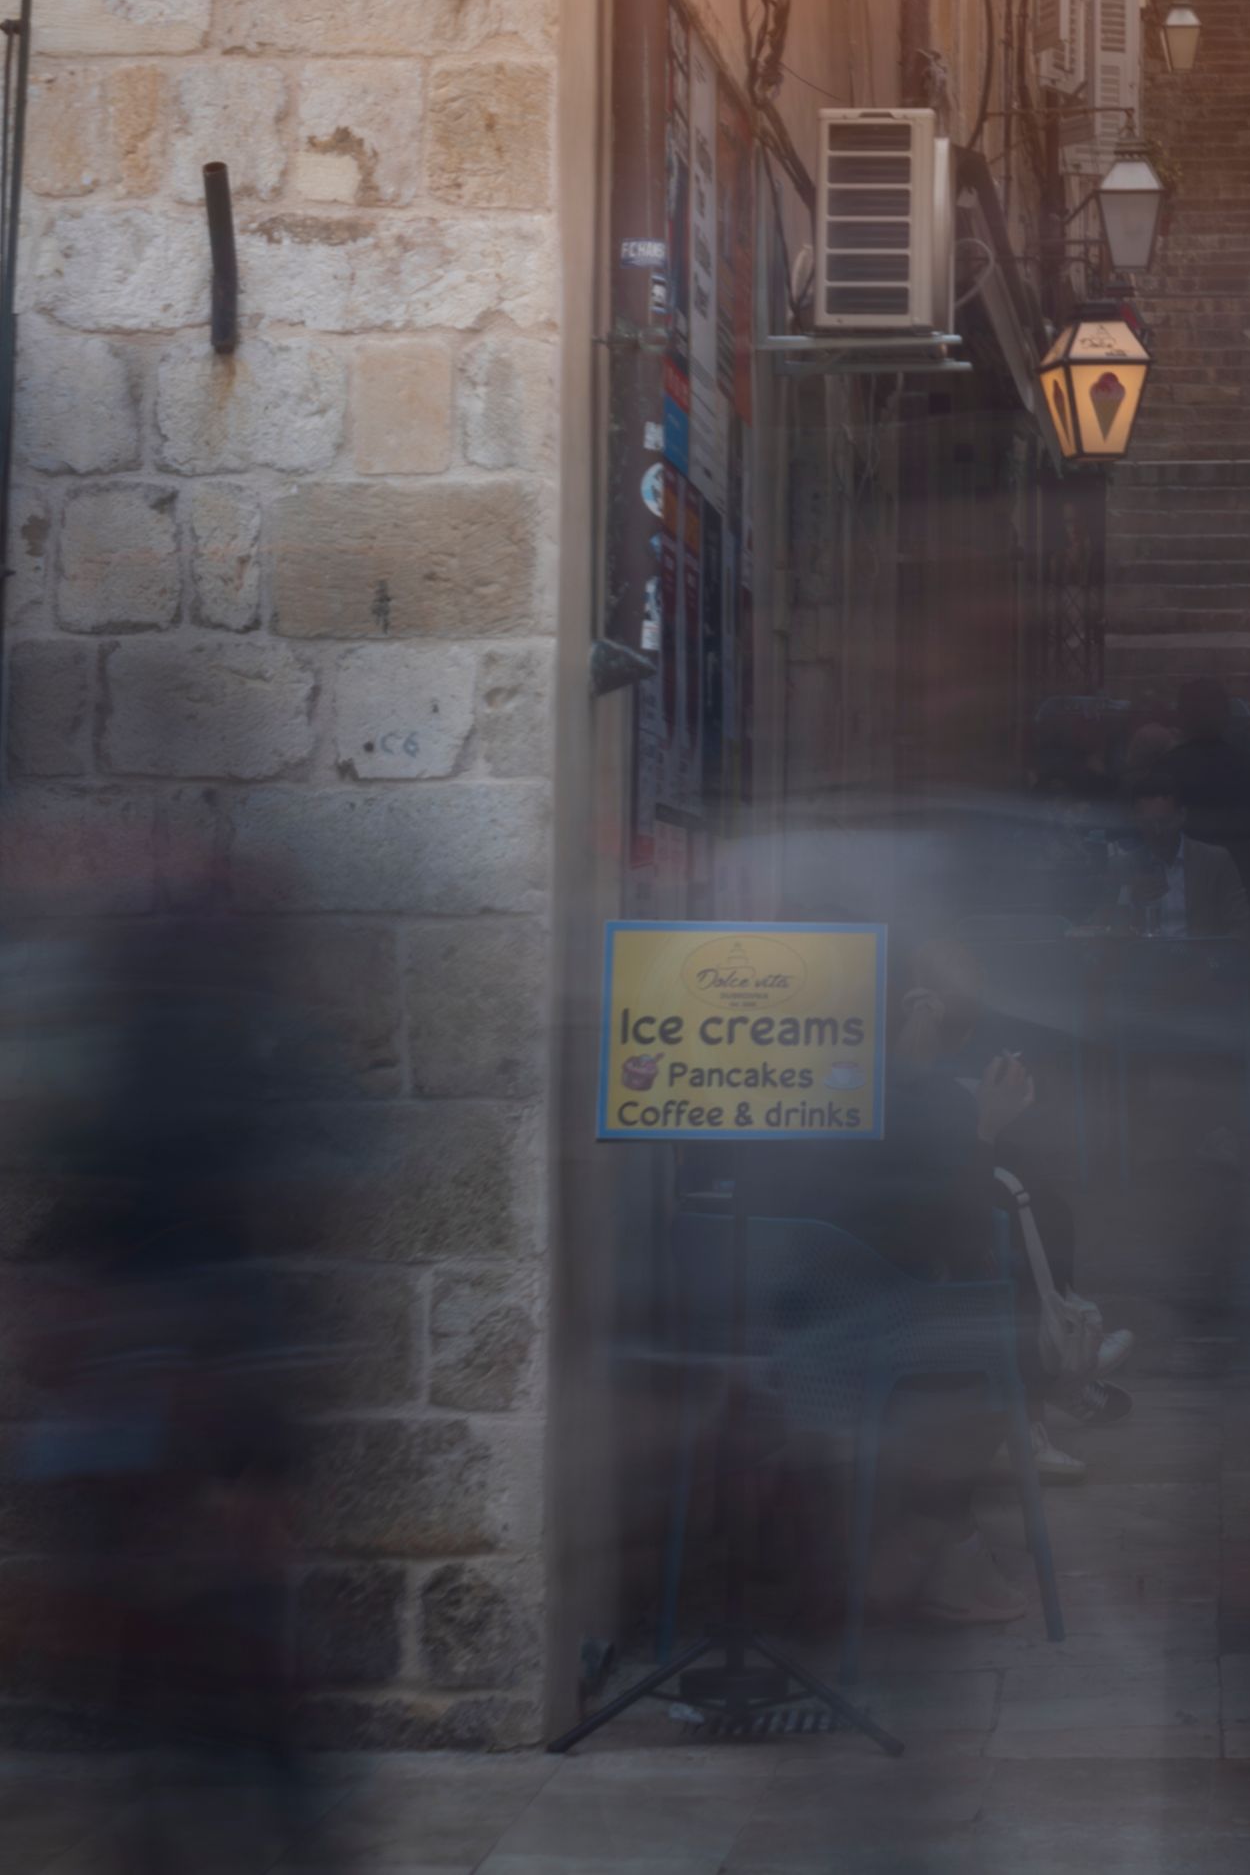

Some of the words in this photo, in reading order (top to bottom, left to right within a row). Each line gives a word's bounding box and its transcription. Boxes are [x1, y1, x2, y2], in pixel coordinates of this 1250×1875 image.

[696, 967, 750, 991] Dolce
[620, 1008, 685, 1046] Ice
[699, 1015, 865, 1047] creams
[668, 1061, 814, 1089] Pancakes
[617, 1099, 724, 1128] Coffee
[733, 1100, 754, 1127] &
[764, 1100, 861, 1128] drinks
